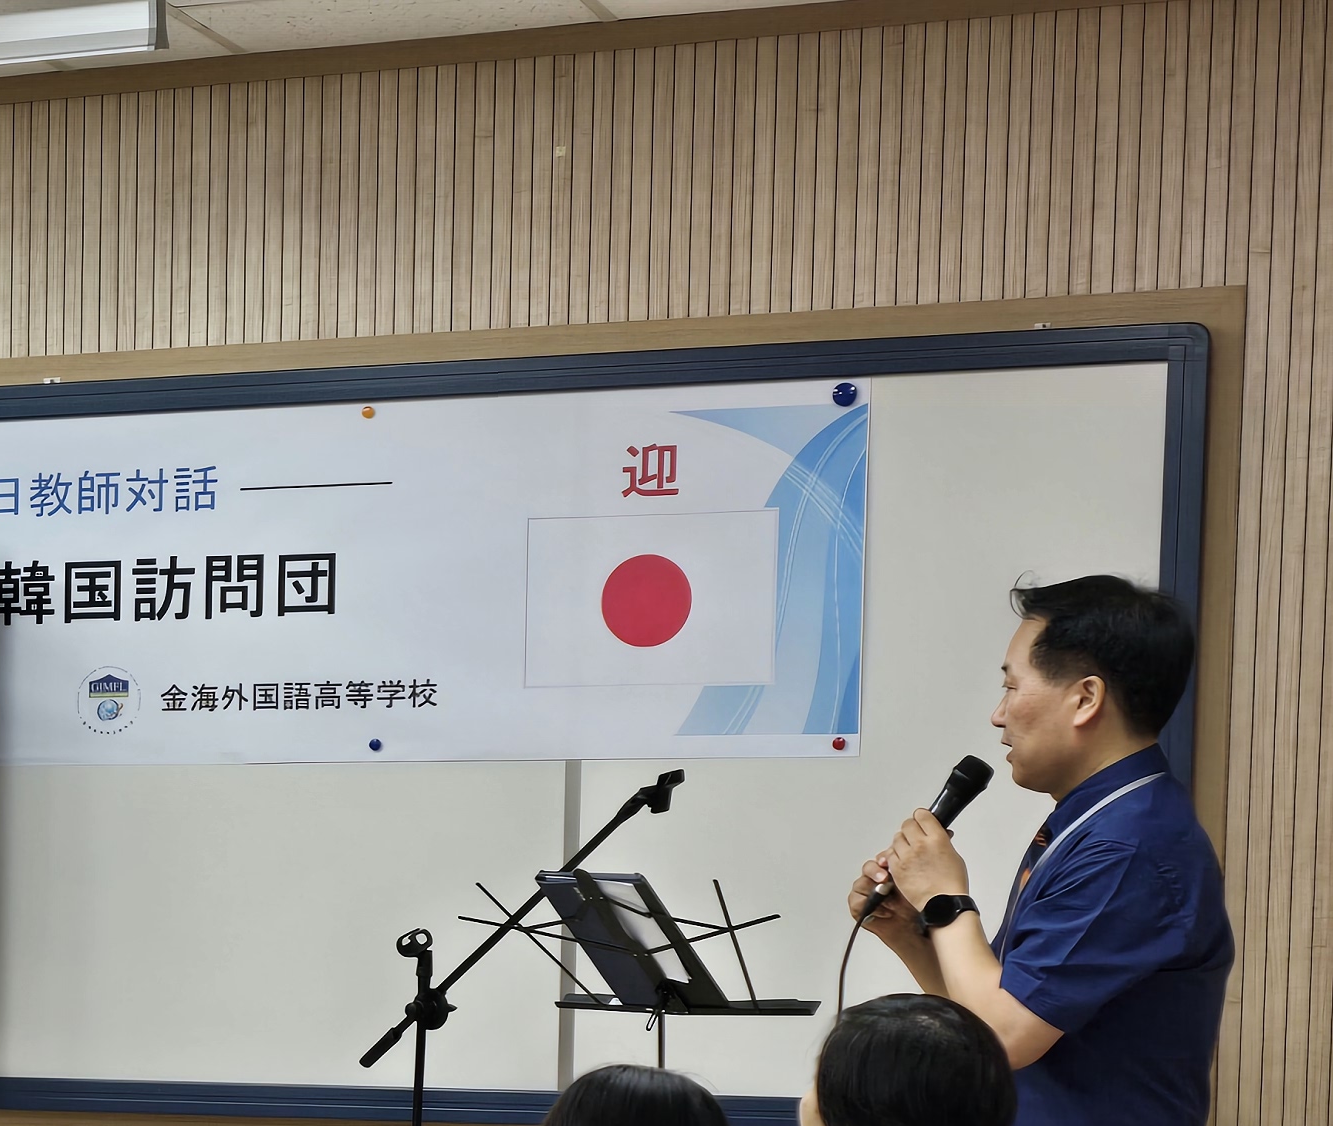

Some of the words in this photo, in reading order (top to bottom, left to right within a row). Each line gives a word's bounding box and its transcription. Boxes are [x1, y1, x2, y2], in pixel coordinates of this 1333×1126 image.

[621, 443, 679, 498] 迎
[160, 678, 439, 712] 金海外国語高等学校
